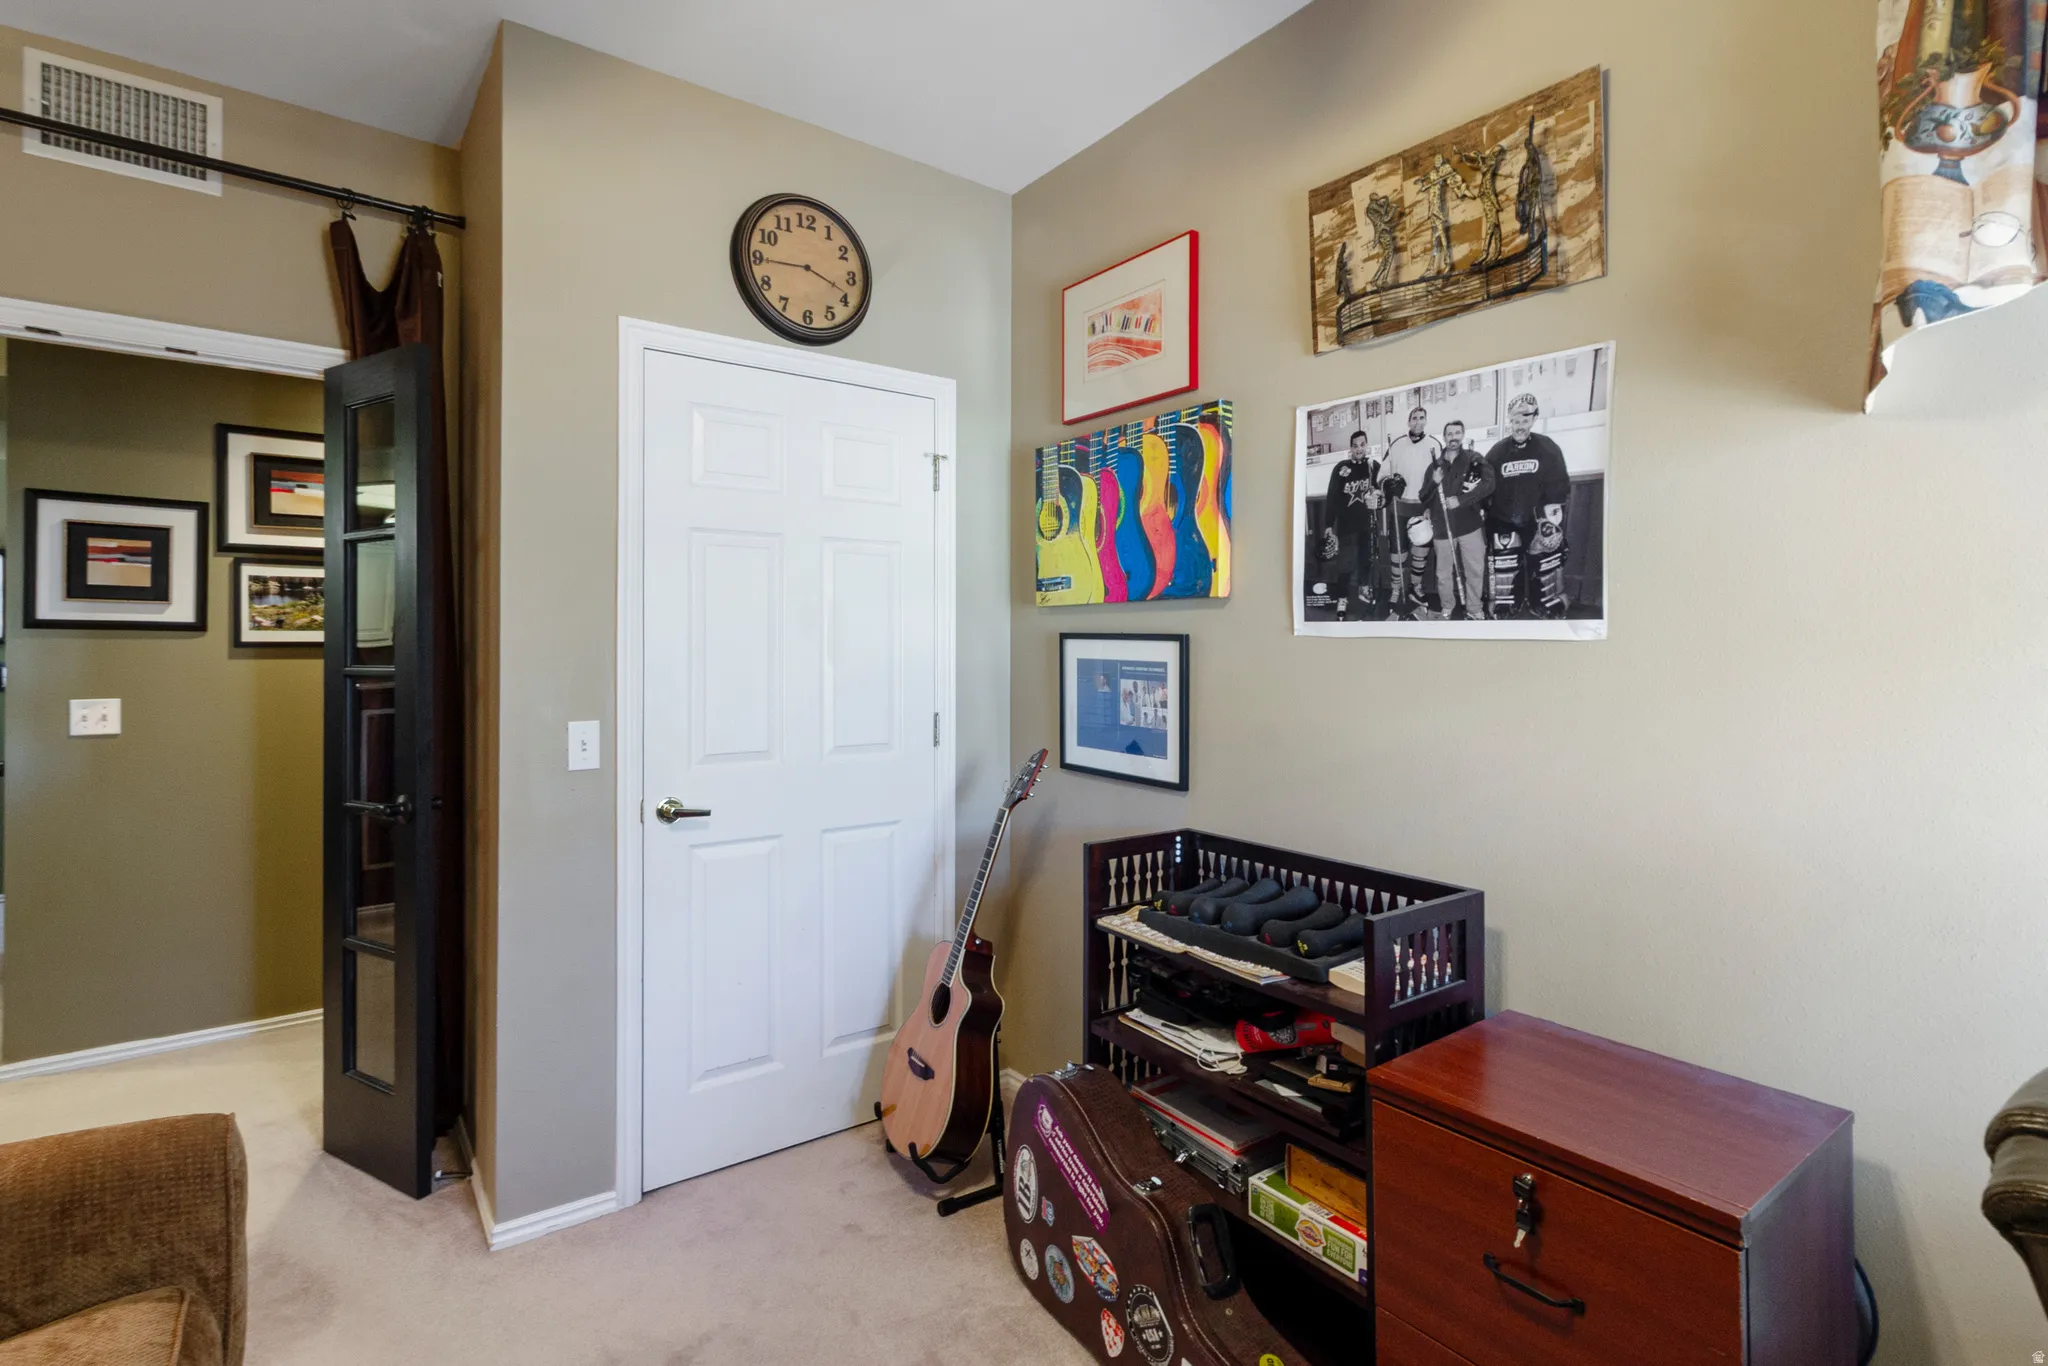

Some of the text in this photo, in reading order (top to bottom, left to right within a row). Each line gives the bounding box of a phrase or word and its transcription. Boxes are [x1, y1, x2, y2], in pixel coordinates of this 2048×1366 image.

[774, 214, 793, 233] 11
[796, 212, 816, 232] 12
[759, 228, 778, 246] 10
[824, 225, 833, 241] 1
[752, 249, 764, 266] 9
[838, 245, 849, 262] 2
[760, 275, 771, 291] 8
[845, 271, 857, 287] 3
[778, 295, 789, 312] 7
[839, 293, 849, 307] 4
[802, 309, 814, 325] 6
[824, 305, 836, 321] 5
